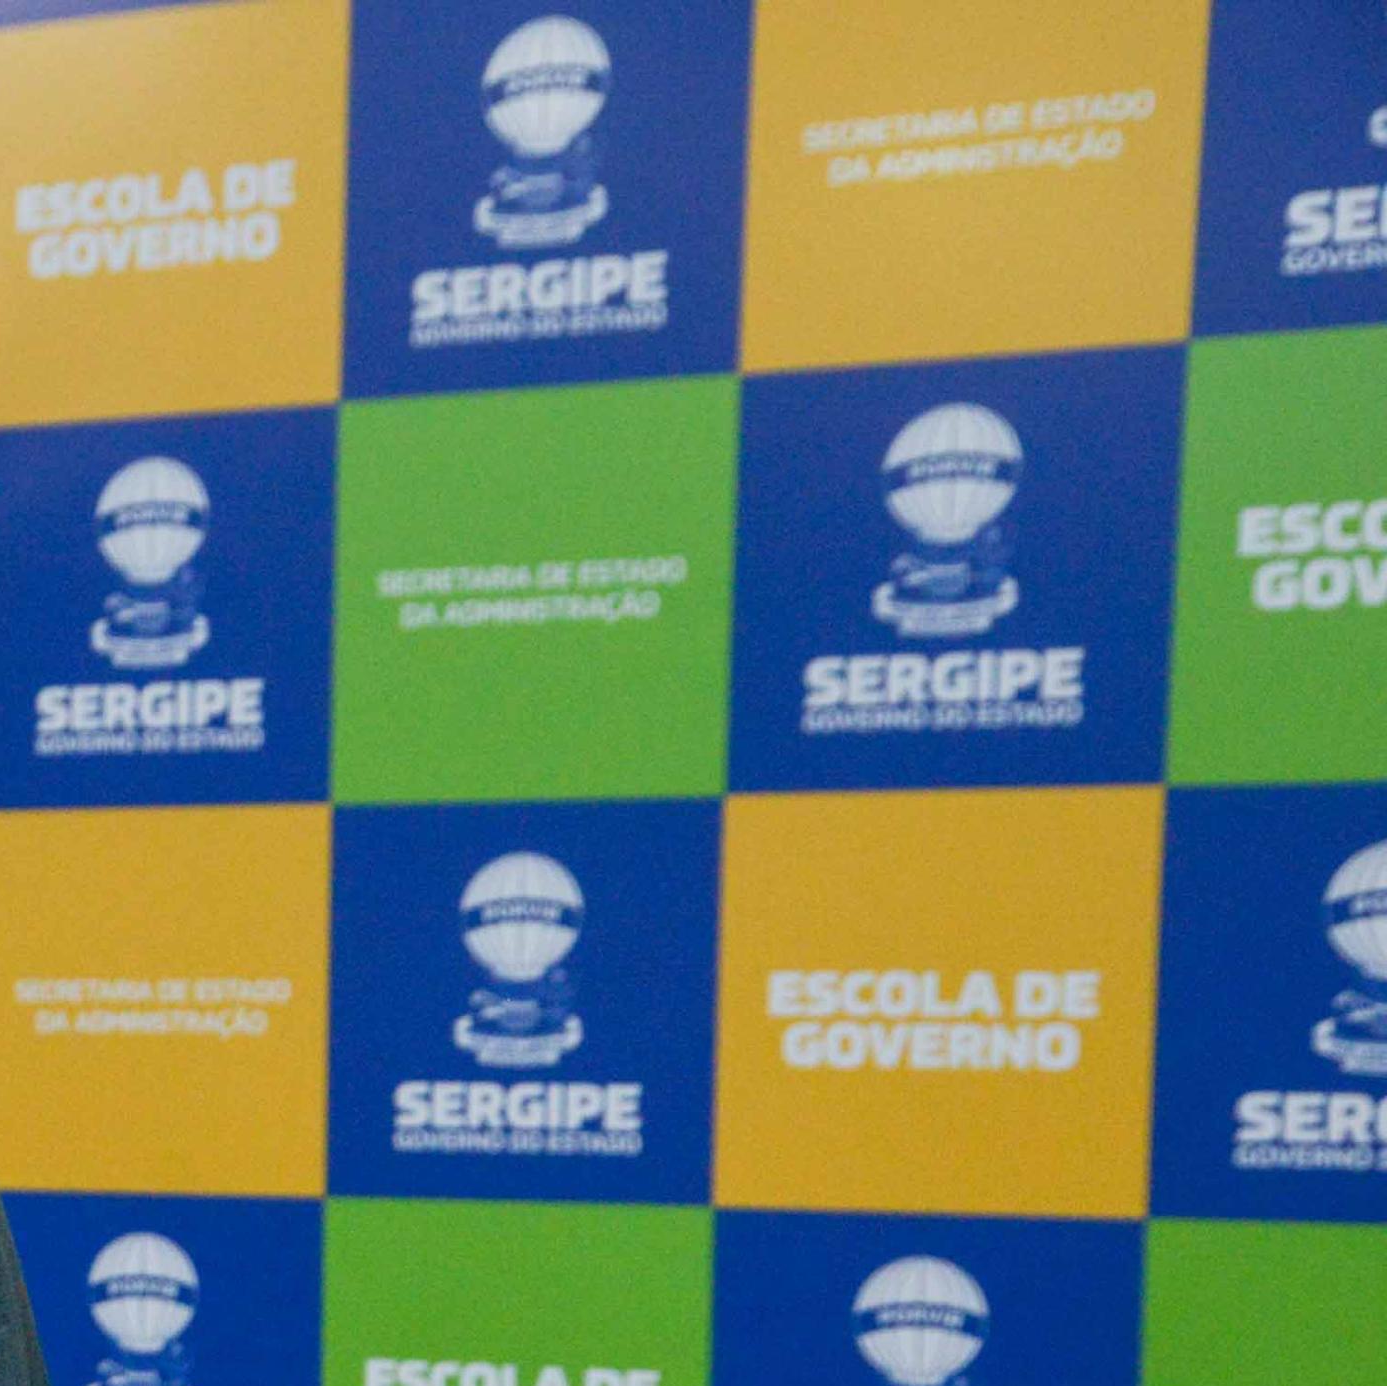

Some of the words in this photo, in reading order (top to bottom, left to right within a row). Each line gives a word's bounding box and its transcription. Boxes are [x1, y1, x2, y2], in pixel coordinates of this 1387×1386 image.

[801, 105, 977, 154] SECRETARIA
[983, 102, 1024, 134] DE
[1030, 88, 1156, 129] ESTADO
[828, 153, 871, 187] DA
[876, 128, 1123, 182] ADMINISTRAÇÃO
[14, 167, 215, 233] ESCOLA
[222, 158, 297, 210] DE
[29, 212, 281, 280] GOVERNO
[412, 250, 669, 319] SERGIPE
[377, 564, 532, 596] SECRETARIA
[537, 560, 570, 589] DE
[578, 554, 688, 587] ESTADO
[399, 600, 437, 630] DA
[444, 588, 661, 628] ADMINISTRAÇÃO
[803, 647, 1084, 707] SERGIPE
[35, 678, 265, 731] SERGIPE
[15, 979, 153, 1004] SECRETARIA
[156, 979, 187, 1003] DE
[194, 978, 292, 1004] ESTADO
[765, 970, 1002, 1019] ESCOLA
[1014, 970, 1100, 1019] DE
[35, 1009, 68, 1034] DA
[75, 1007, 269, 1041] ADMINISTRAÇÃO
[781, 1022, 1081, 1072] GOVERNO
[393, 1080, 642, 1131] SERGIPE
[1234, 1090, 1387, 1143] SER
